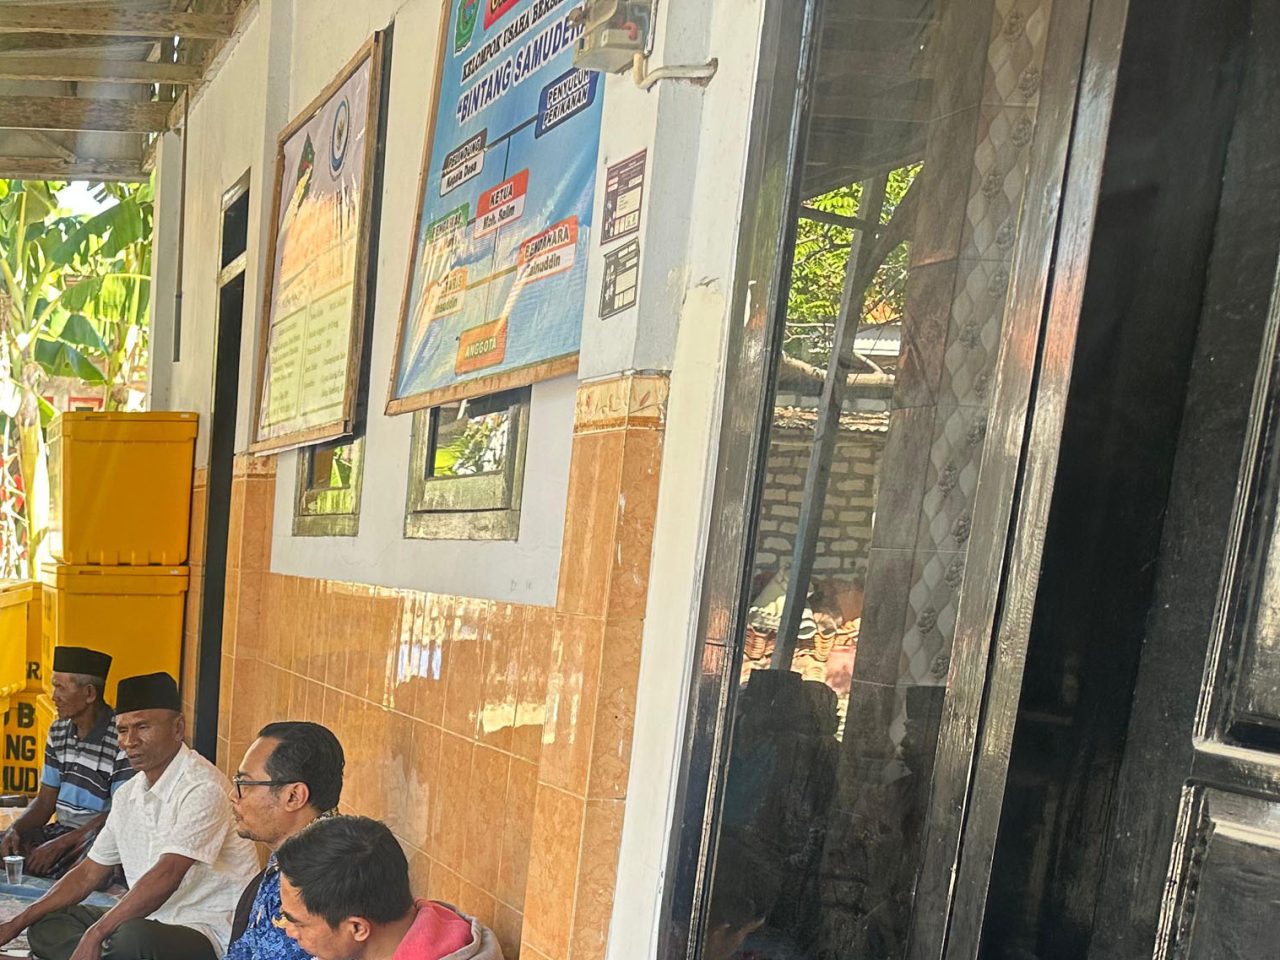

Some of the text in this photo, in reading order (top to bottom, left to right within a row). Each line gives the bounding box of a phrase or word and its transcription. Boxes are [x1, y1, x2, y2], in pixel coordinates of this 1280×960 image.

[462, 33, 502, 82] KELOMPOK
[503, 11, 530, 47] USAHA
[548, 69, 590, 104] PENYULUH
[544, 87, 588, 126] PERIKANAN
[489, 185, 513, 207] KETUA
[525, 226, 569, 257] BENDAHARA
[465, 336, 497, 360] ANGGOTA
